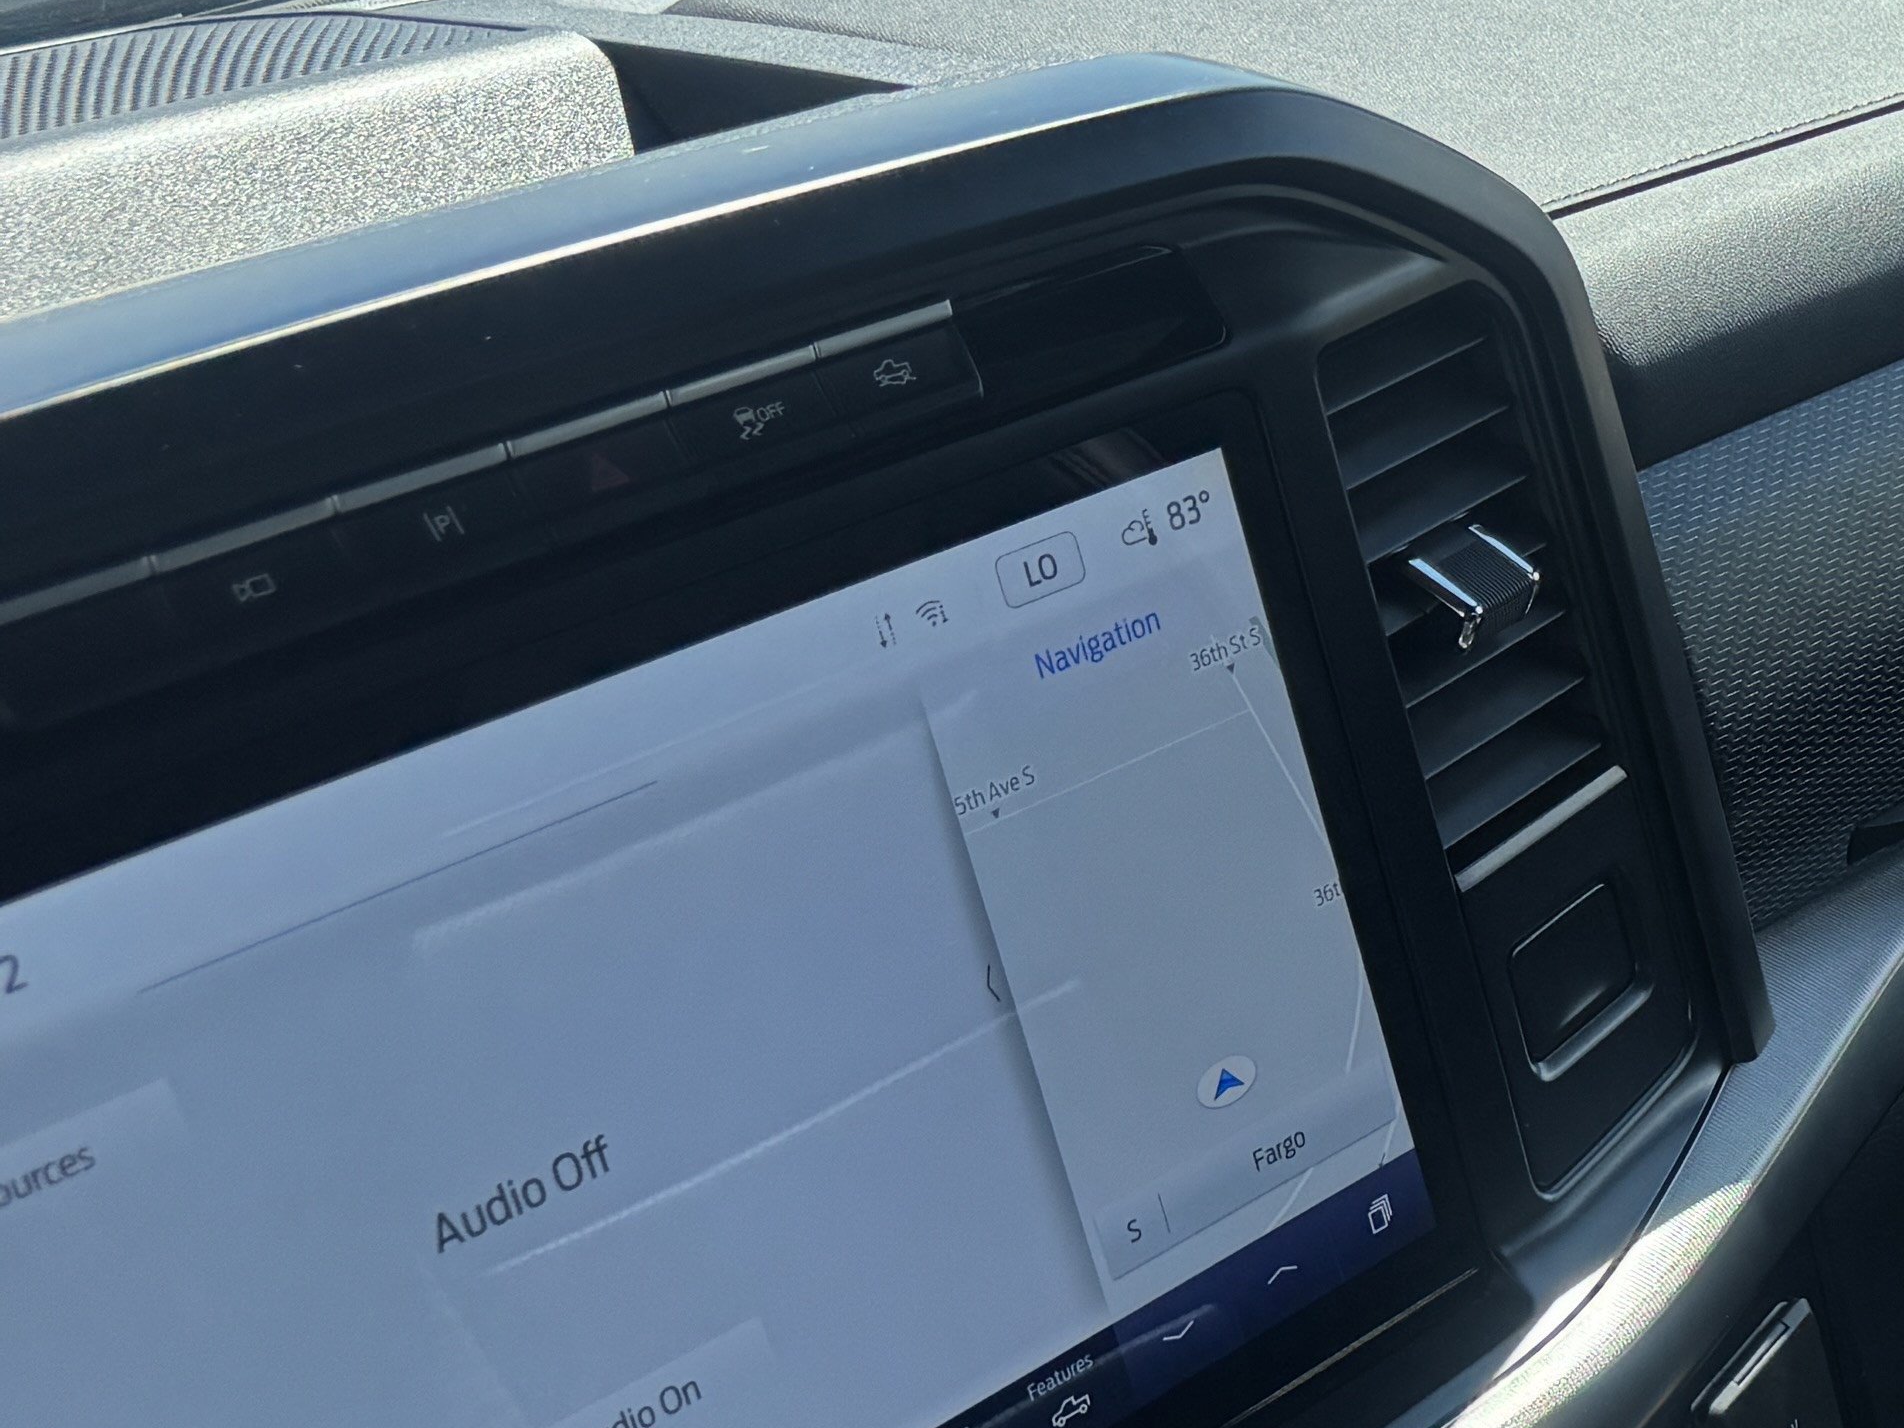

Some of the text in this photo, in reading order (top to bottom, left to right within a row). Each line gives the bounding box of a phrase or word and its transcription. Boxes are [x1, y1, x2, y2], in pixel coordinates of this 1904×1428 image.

[757, 400, 787, 422] OFF
[1165, 489, 1211, 532] 83°
[1022, 552, 1059, 589] LO
[1033, 611, 1162, 680] Navigation
[1189, 626, 1263, 673] 36th St S
[953, 764, 1036, 817] 5th Ave S
[1251, 1128, 1307, 1172] Fargo
[435, 1133, 610, 1254] Audio Off
[1126, 1219, 1143, 1244] S
[658, 1379, 703, 1416] On
[1026, 1352, 1095, 1402] Features
